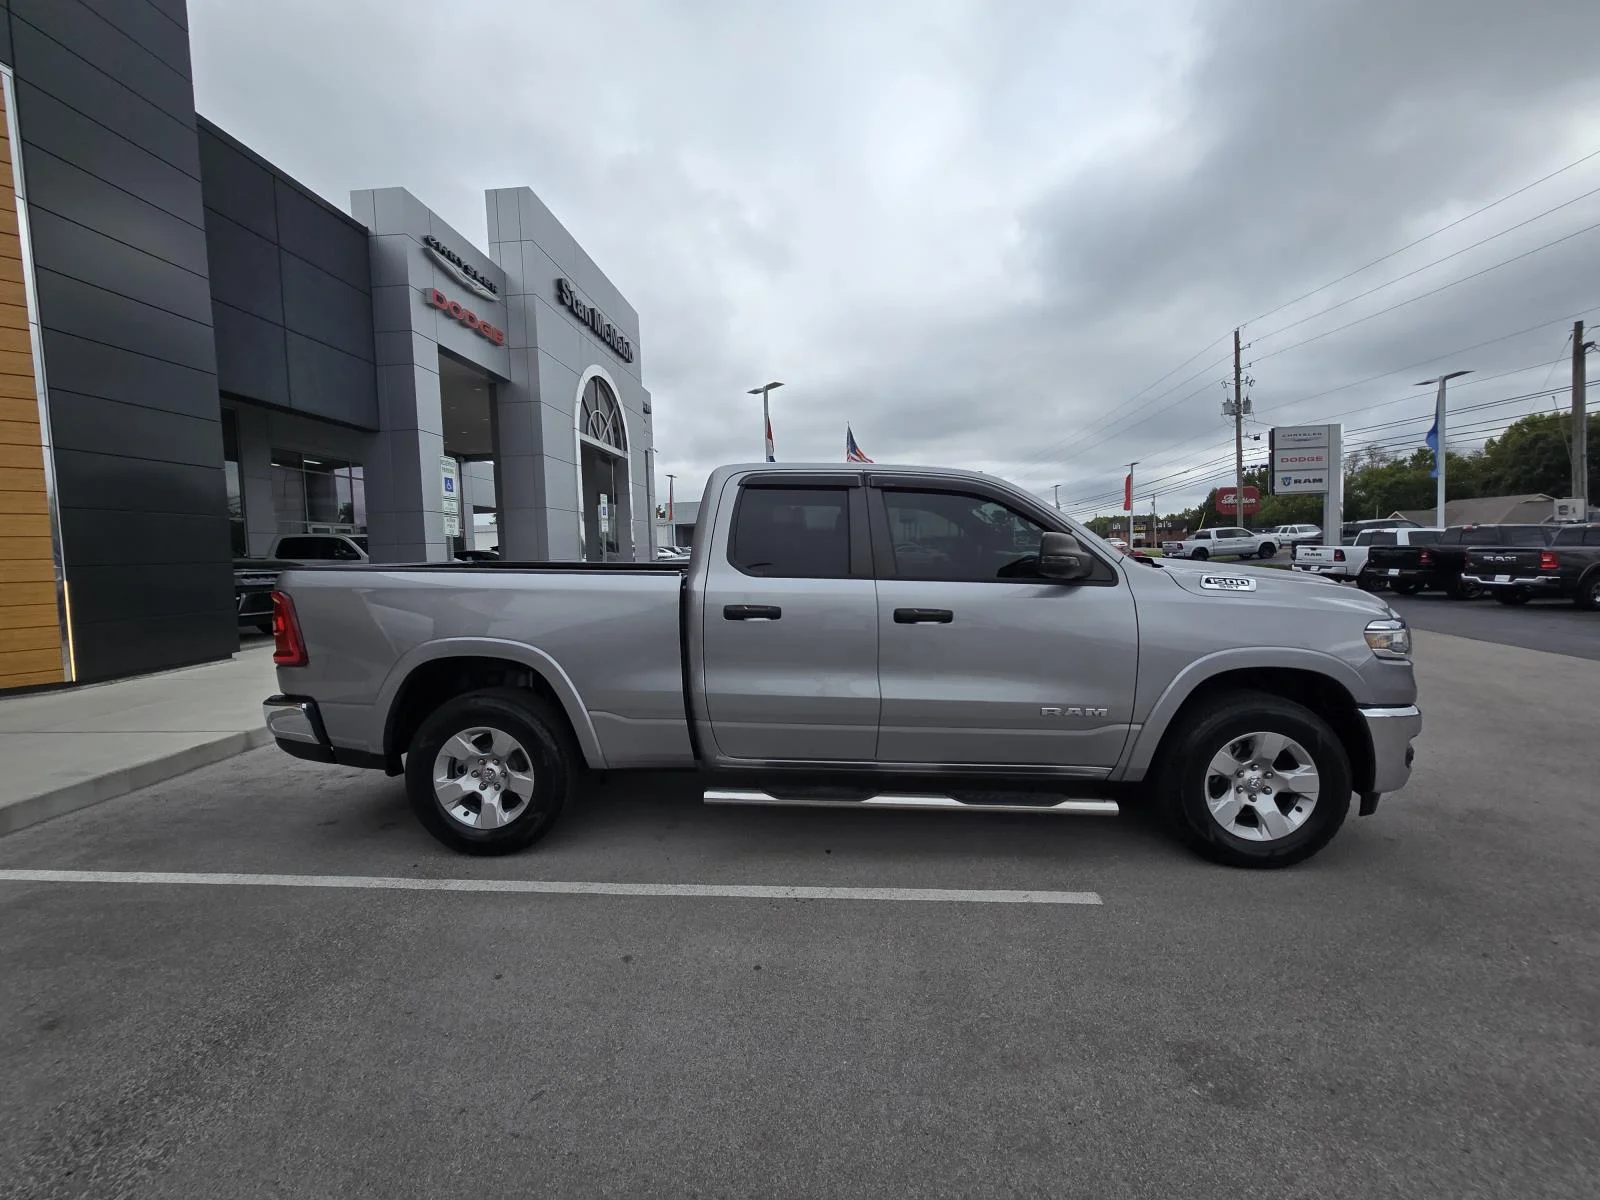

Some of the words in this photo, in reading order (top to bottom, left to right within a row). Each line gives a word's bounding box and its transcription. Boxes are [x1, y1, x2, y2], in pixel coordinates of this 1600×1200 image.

[557, 277, 592, 327] Stan
[424, 287, 505, 347] DODGE
[1281, 455, 1325, 463] DODGE
[1293, 477, 1323, 485] RAM
[1209, 577, 1249, 586] 1500
[1040, 706, 1108, 717] RAM
